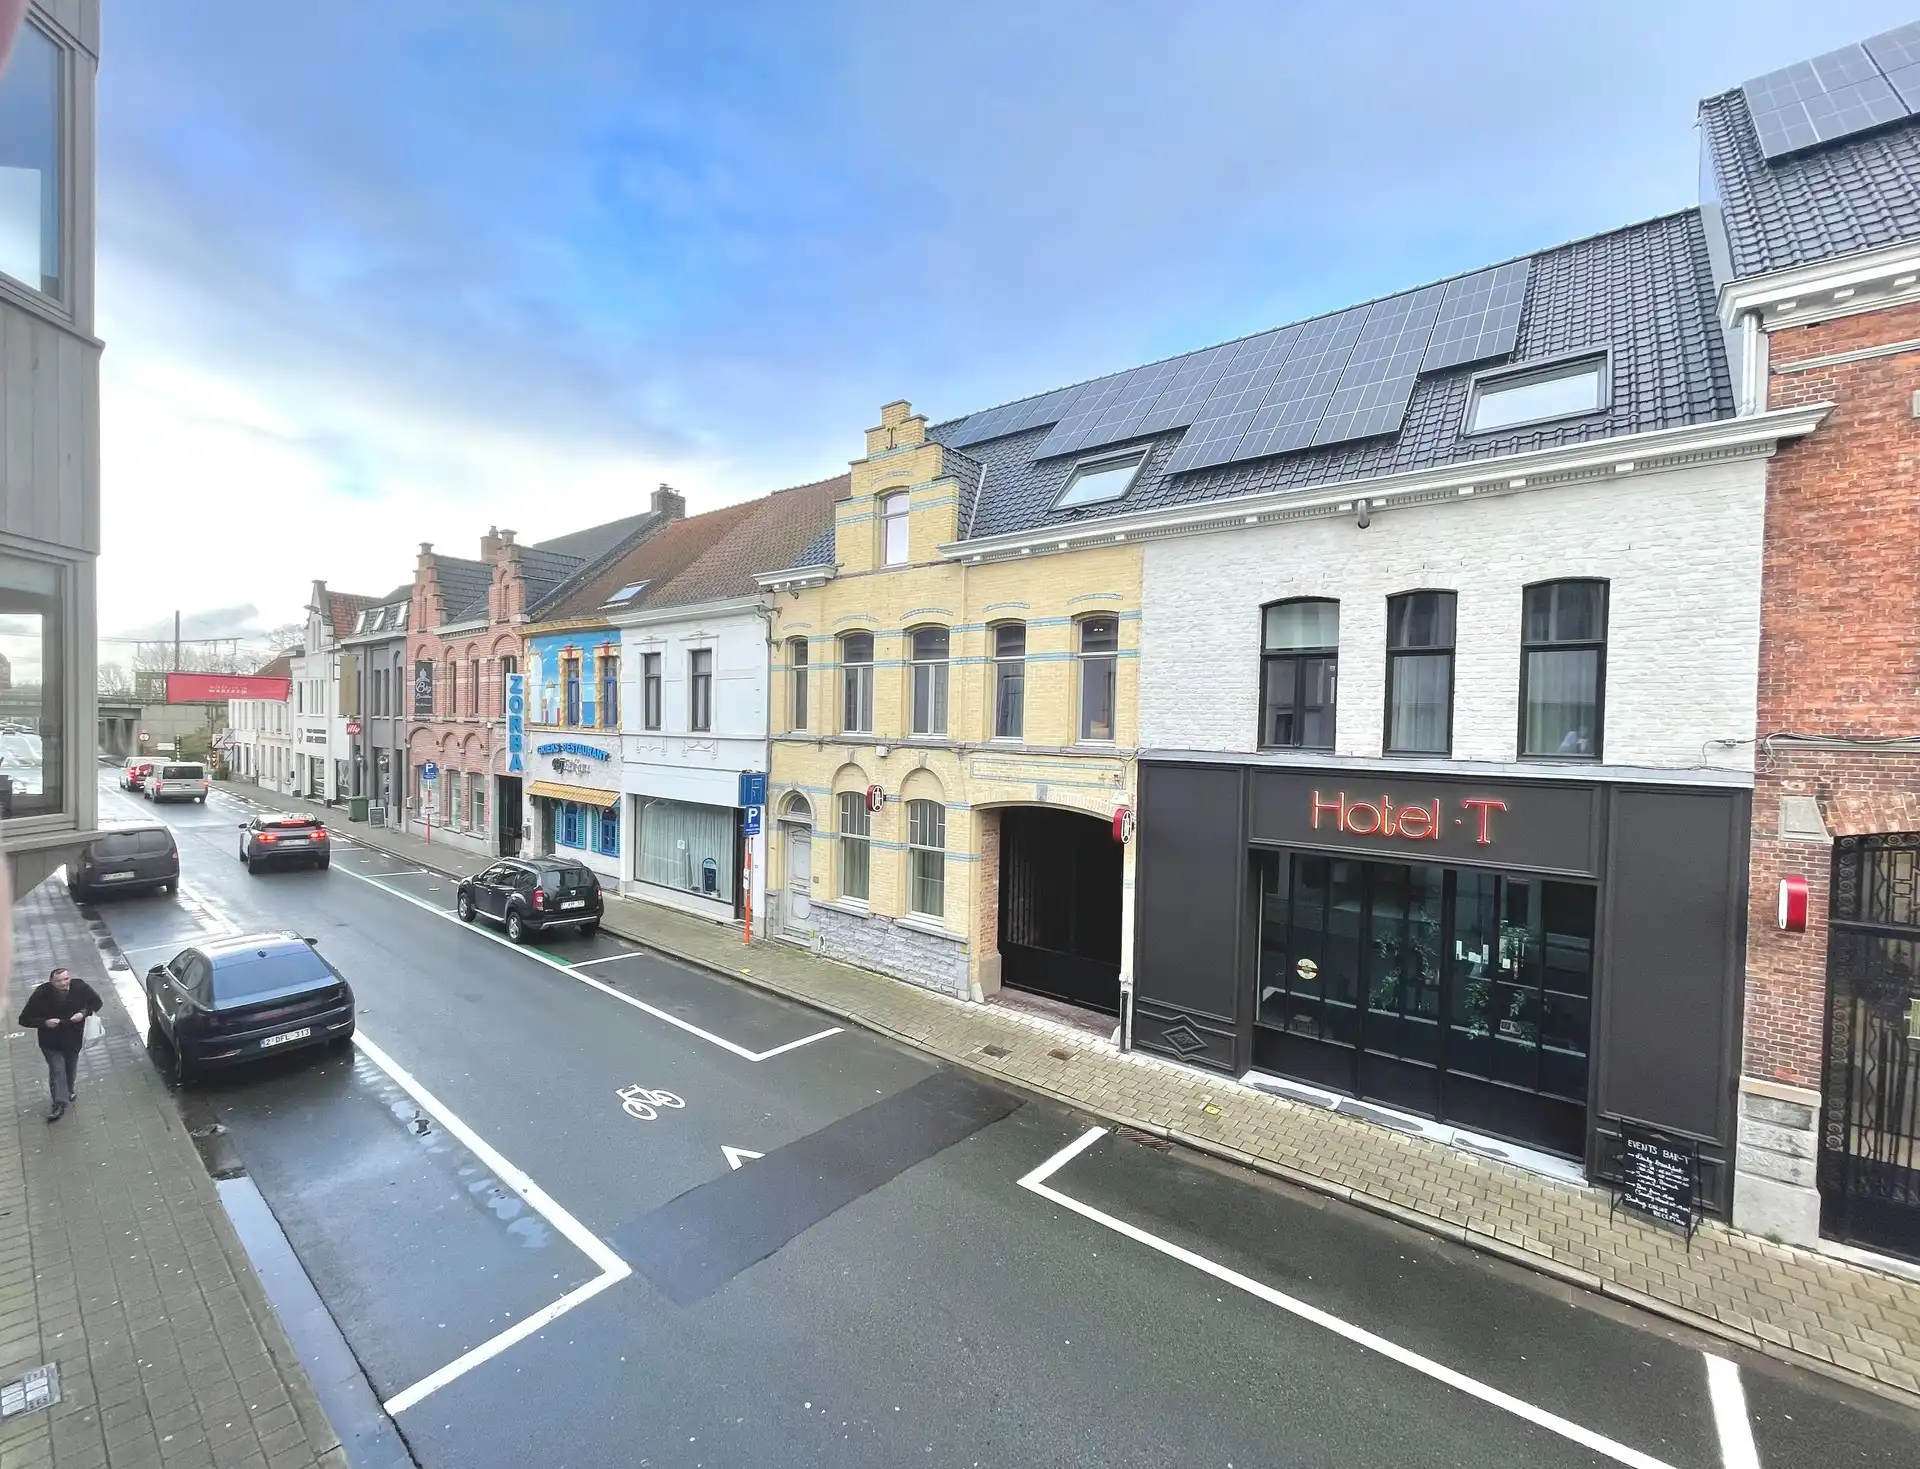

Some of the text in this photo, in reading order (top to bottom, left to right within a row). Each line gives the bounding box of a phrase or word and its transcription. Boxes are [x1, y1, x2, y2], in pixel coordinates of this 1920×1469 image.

[347, 724, 360, 734] illy
[509, 675, 523, 772] ZORBA
[561, 743, 608, 761] RESTAURANT
[425, 763, 434, 773] P
[748, 808, 759, 823] P
[1312, 790, 1440, 840] Hotel
[1627, 1140, 1657, 1155] EVENTS
